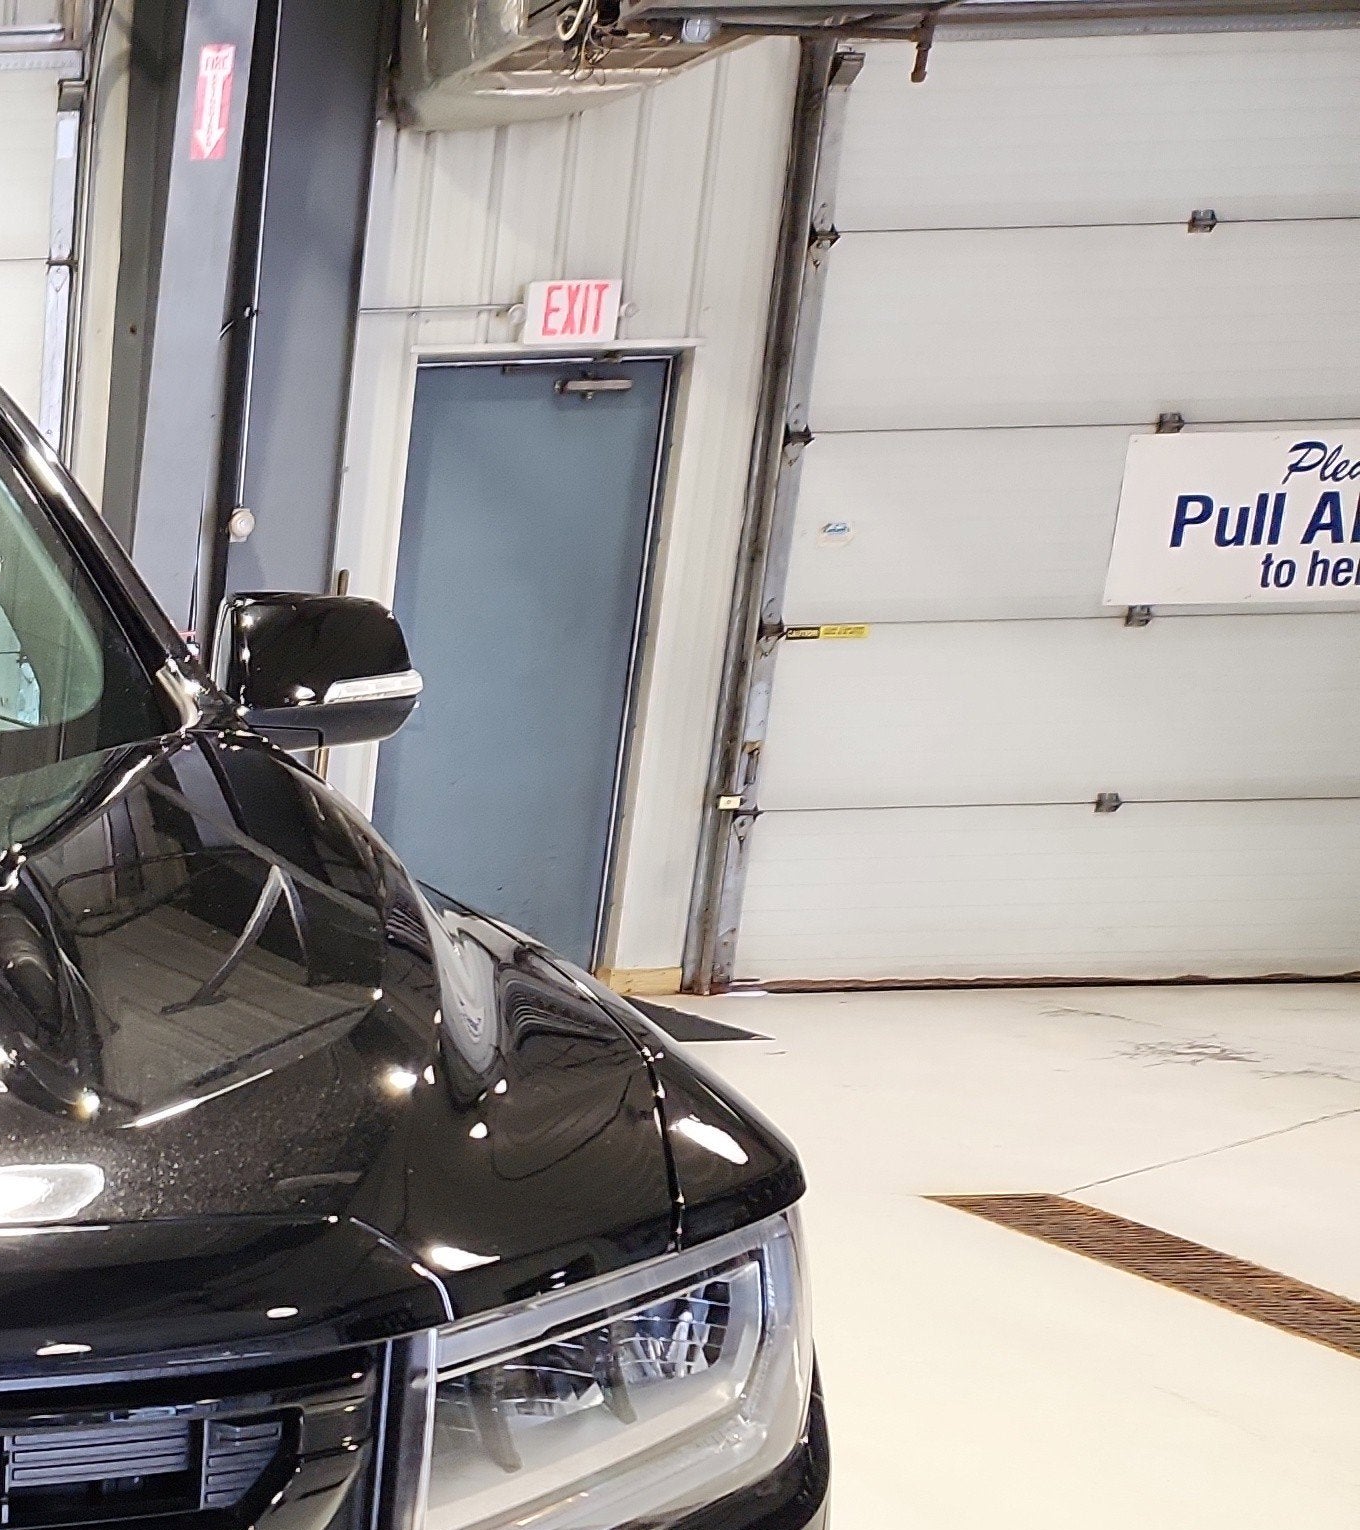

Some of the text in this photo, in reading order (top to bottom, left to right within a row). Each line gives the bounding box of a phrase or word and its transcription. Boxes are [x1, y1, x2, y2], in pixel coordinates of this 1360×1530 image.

[541, 284, 610, 336] EXIT
[1169, 490, 1360, 549] Pull A
[1260, 552, 1296, 588] to
